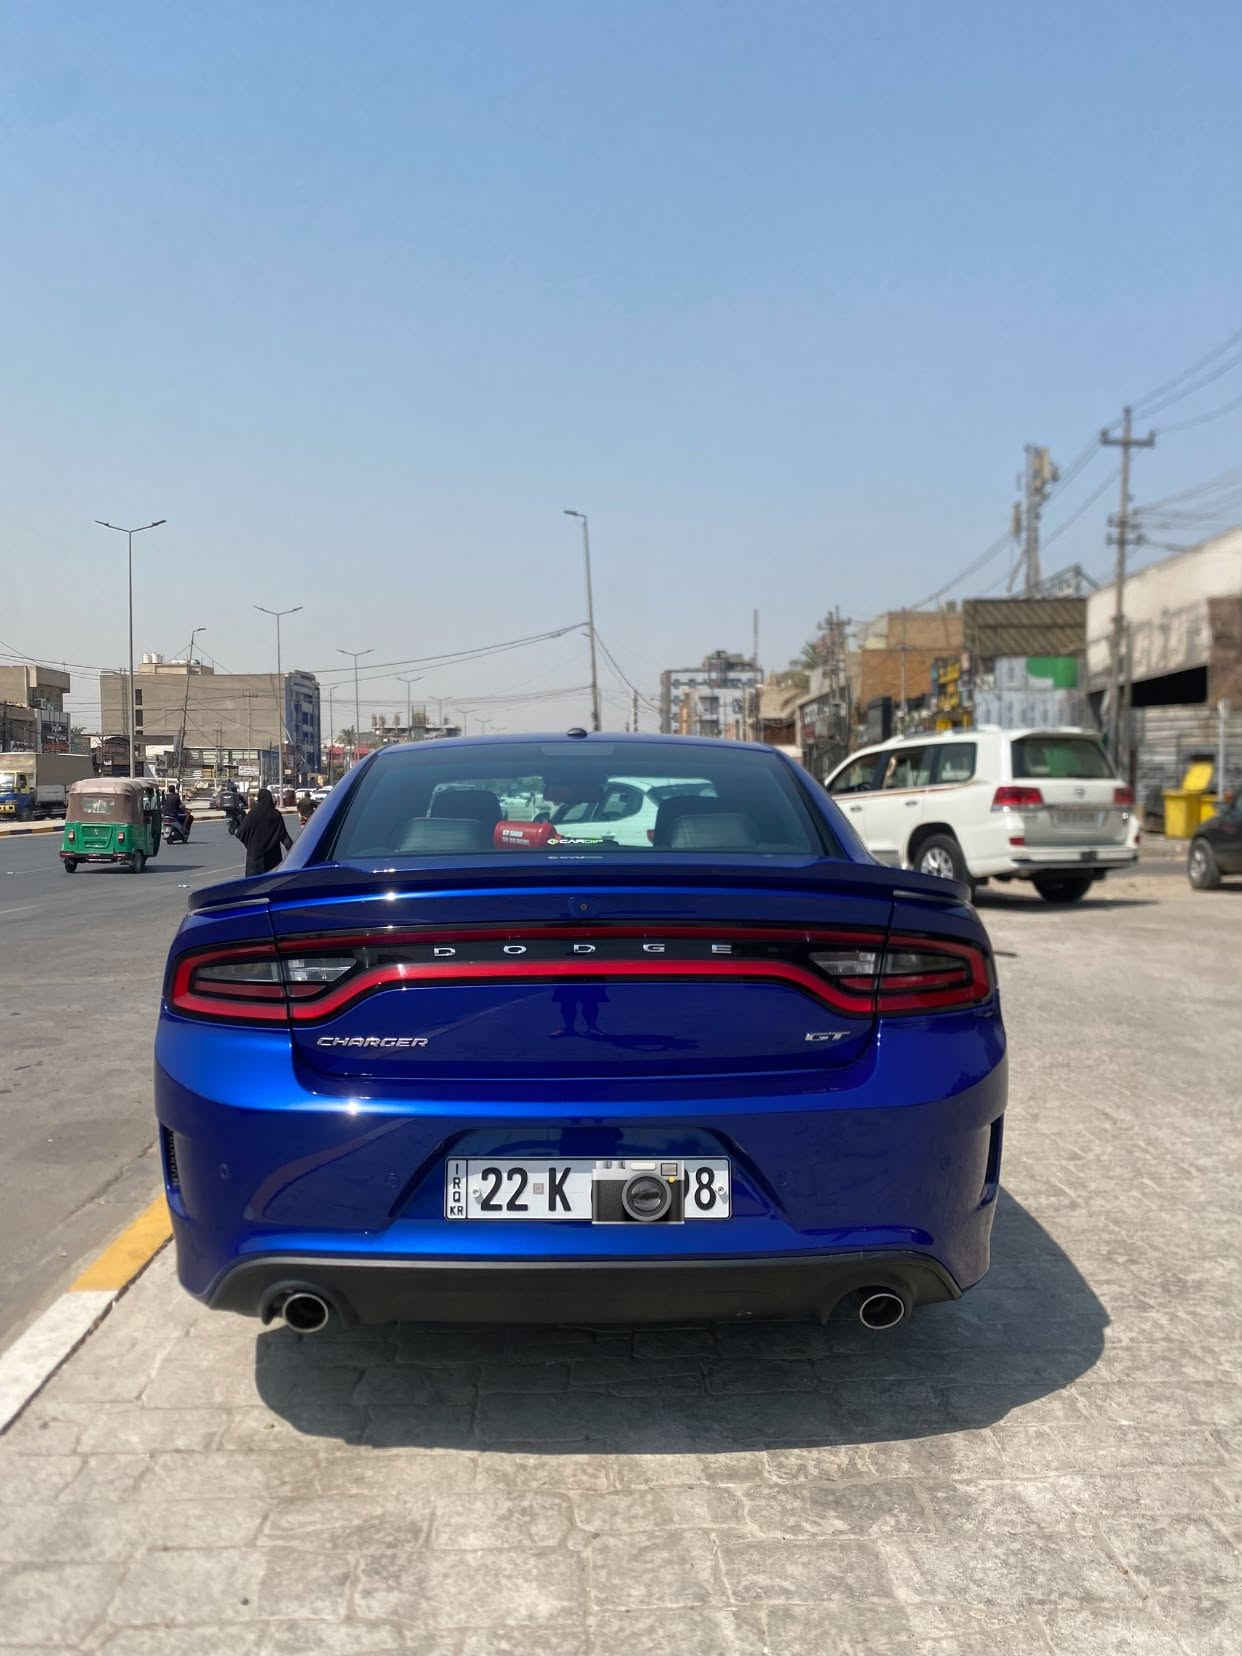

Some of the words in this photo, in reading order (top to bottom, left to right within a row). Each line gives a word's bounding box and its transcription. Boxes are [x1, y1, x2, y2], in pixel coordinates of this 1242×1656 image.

[434, 944, 733, 957] DODGE
[316, 1037, 428, 1047] CHARGER
[805, 1031, 850, 1041] GT
[453, 1163, 461, 1203] IRQ
[480, 1167, 528, 1211] 22
[548, 1167, 572, 1211] K
[450, 1205, 464, 1216] KR
